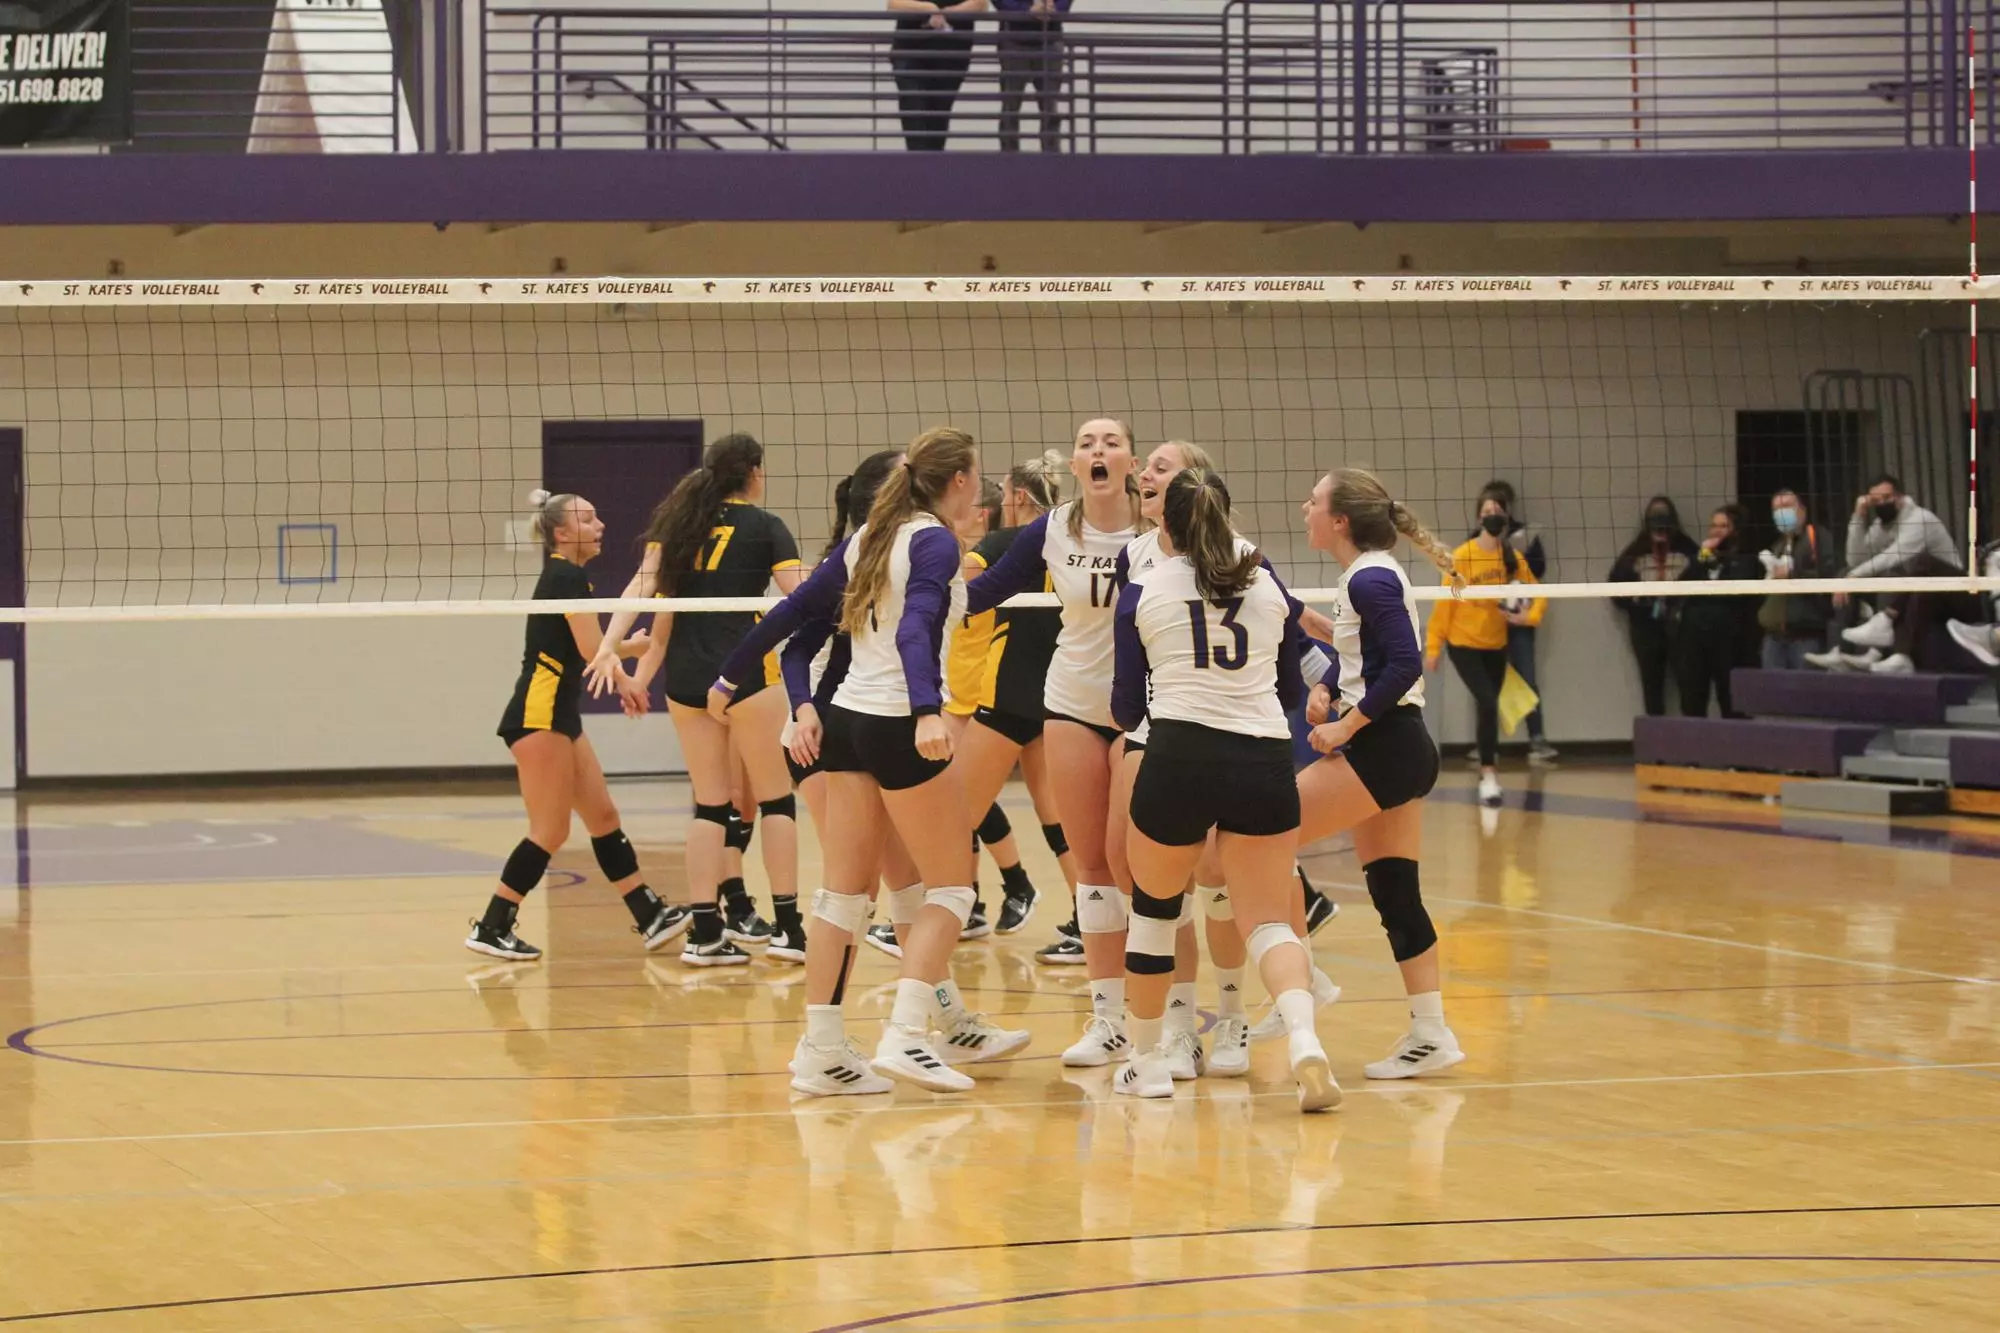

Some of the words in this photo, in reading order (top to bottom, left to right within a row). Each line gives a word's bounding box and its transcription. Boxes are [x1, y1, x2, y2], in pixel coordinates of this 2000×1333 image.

[0, 33, 12, 71] E
[14, 31, 107, 70] DELIVER!
[0, 76, 104, 104] 51.698.8828
[63, 284, 80, 296] ST.
[88, 284, 133, 296] KATE'S
[142, 284, 220, 296] VOLLEYBALL
[293, 283, 310, 295] ST.
[319, 283, 363, 295] KATE'S
[372, 283, 449, 295] VOLLEYBALL
[521, 282, 537, 294] ST.
[546, 282, 589, 294] KATE'S
[598, 282, 673, 294] VOLLEYBALL
[744, 281, 760, 293] ST.
[769, 281, 812, 293] KATE'S
[820, 281, 895, 293] VOLLEYBALL
[965, 281, 981, 293] ST.
[989, 281, 1031, 293] KATE'S
[1040, 281, 1113, 293] VOLLEYBALL
[1181, 280, 1197, 292] ST.
[1205, 280, 1246, 292] KATE'S
[1254, 280, 1325, 292] VOLLEYBALL
[1391, 280, 1406, 291] ST.
[1415, 280, 1454, 291] KATE'S
[1462, 280, 1532, 291] VOLLEYBALL
[1597, 280, 1612, 291] ST.
[1620, 280, 1659, 291] KATE'S
[1667, 280, 1735, 291] VOLLEYBALL
[1799, 280, 1813, 291] ST.
[1821, 280, 1859, 291] KATE'S
[1867, 280, 1932, 291] VOLLEYBALL
[1066, 553, 1086, 568] ST.
[1091, 556, 1118, 569] KAT
[1090, 572, 1118, 608] 17
[1184, 597, 1249, 670] 13
